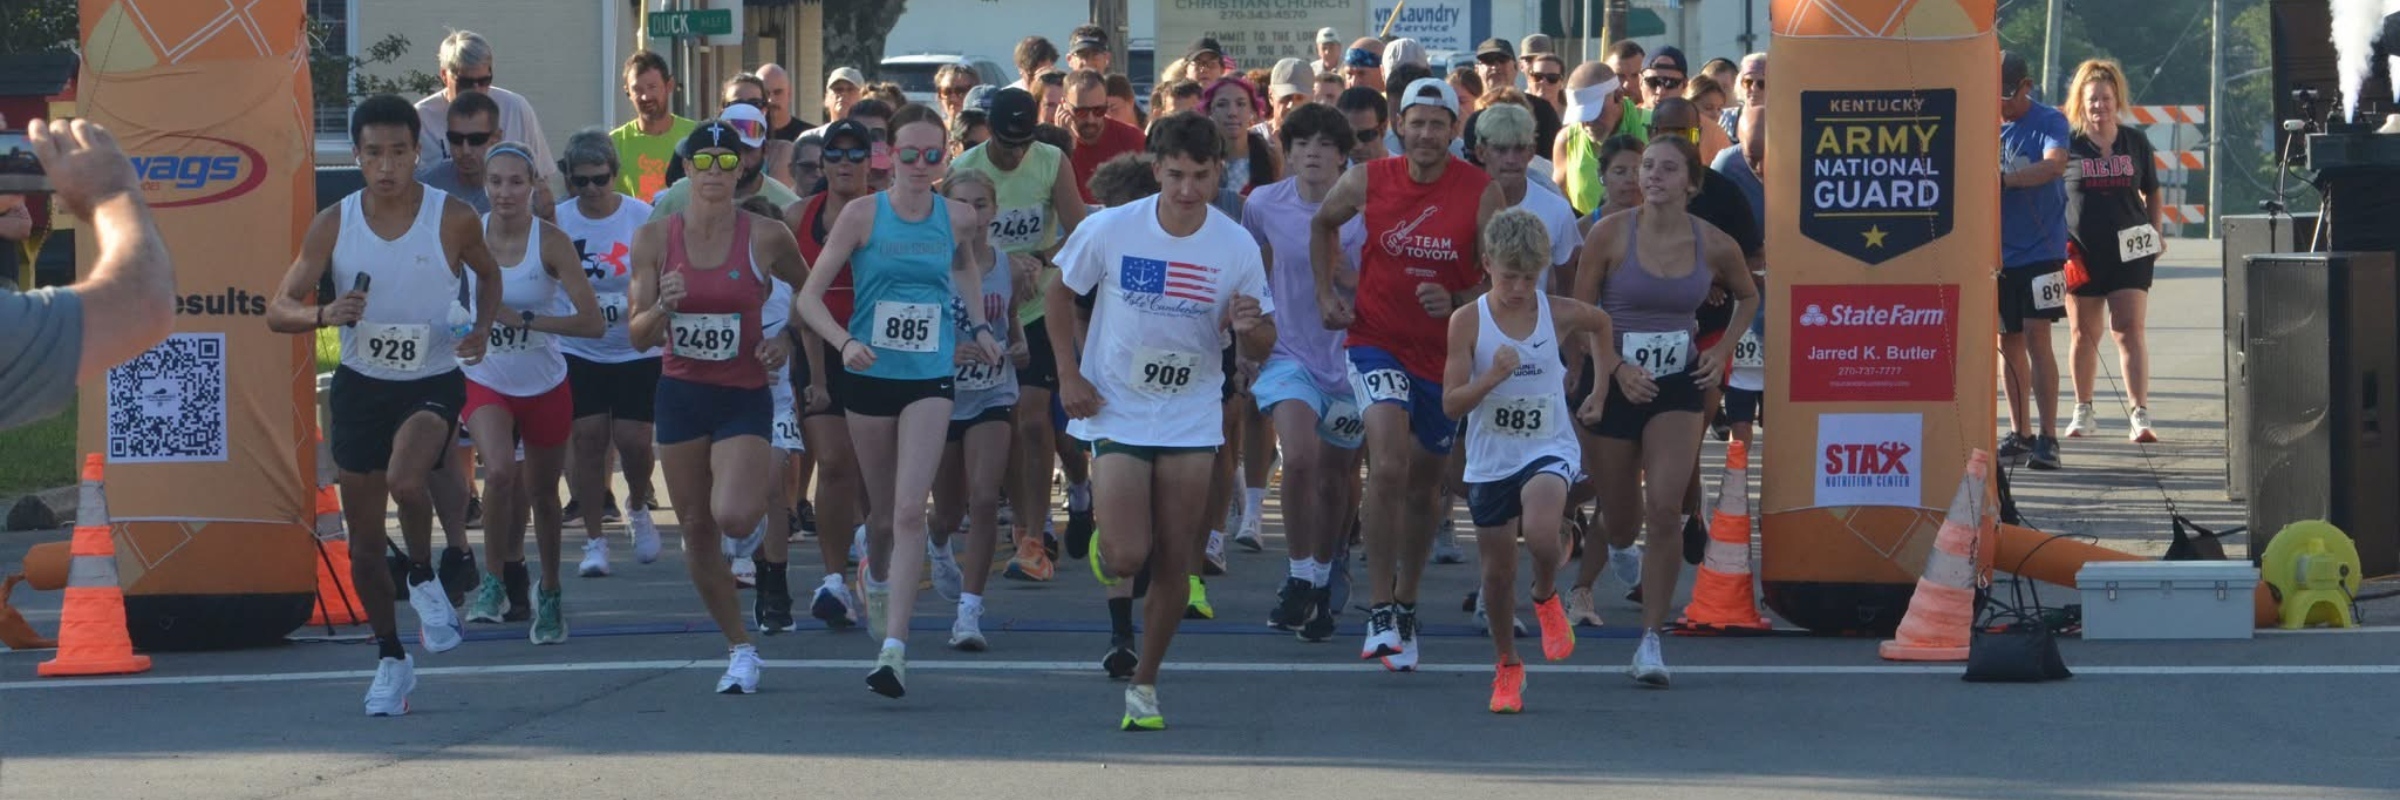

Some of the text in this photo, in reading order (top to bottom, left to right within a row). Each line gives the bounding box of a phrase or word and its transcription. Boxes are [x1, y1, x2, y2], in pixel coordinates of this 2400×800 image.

[1175, 0, 1350, 9] CHRISTIAN CHURCH
[1400, 4, 1459, 27] Laundry
[653, 14, 690, 34] DUCK
[1254, 31, 1265, 41] TO
[1273, 31, 1293, 41] THE
[1296, 31, 1317, 41] LOR
[1830, 99, 1924, 112] KENTUCKY
[1815, 124, 1938, 155] ARMY
[1814, 157, 1939, 176] NATIONAL
[2081, 155, 2134, 177] REDS
[1814, 180, 1939, 208] GUARD
[990, 216, 1040, 238] 2462
[1415, 236, 1452, 249] TEAM
[2126, 234, 2153, 252] 932
[1406, 248, 1459, 260] TOYOTA
[176, 287, 266, 315] esults
[675, 326, 735, 350] 2489
[886, 316, 929, 341] 885
[369, 338, 416, 361] 928
[1635, 346, 1677, 368] 914
[1808, 345, 1937, 360] Jarred K. Butler
[1144, 363, 1191, 386] 908
[1367, 372, 1408, 392] 913
[1838, 367, 1902, 376] 270-737-7777
[1495, 407, 1541, 430] 883
[1825, 442, 1911, 474] STAX
[1825, 475, 1910, 487] NUTRITION CENTER
